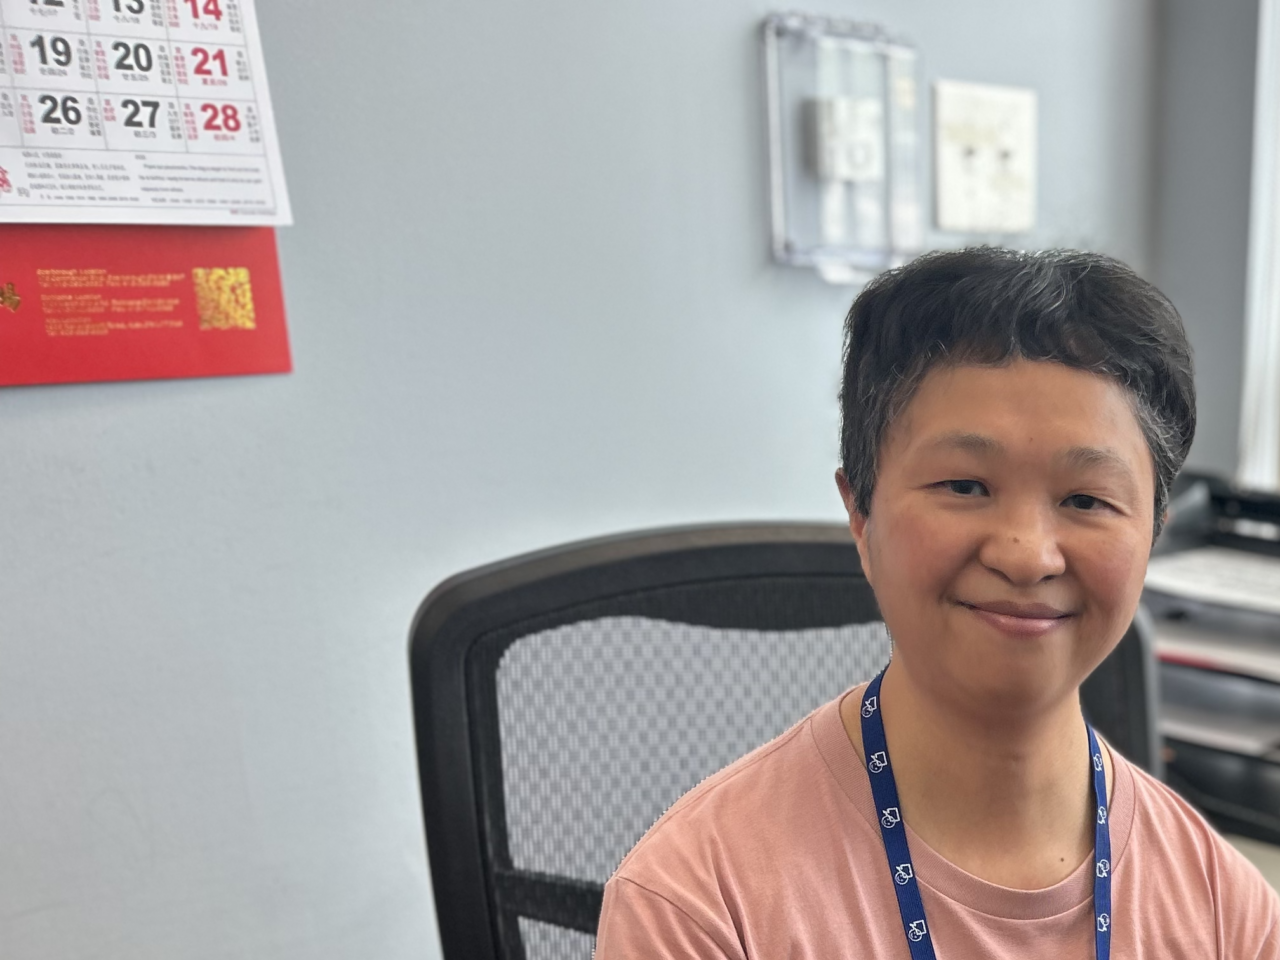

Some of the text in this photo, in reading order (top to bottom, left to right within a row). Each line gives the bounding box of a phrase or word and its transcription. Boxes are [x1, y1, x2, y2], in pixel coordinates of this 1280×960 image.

[30, 34, 72, 67] 19
[112, 40, 153, 72] 20
[191, 46, 228, 77] 21
[38, 94, 82, 125] 26
[121, 99, 160, 128] 27
[200, 103, 241, 132] 28
